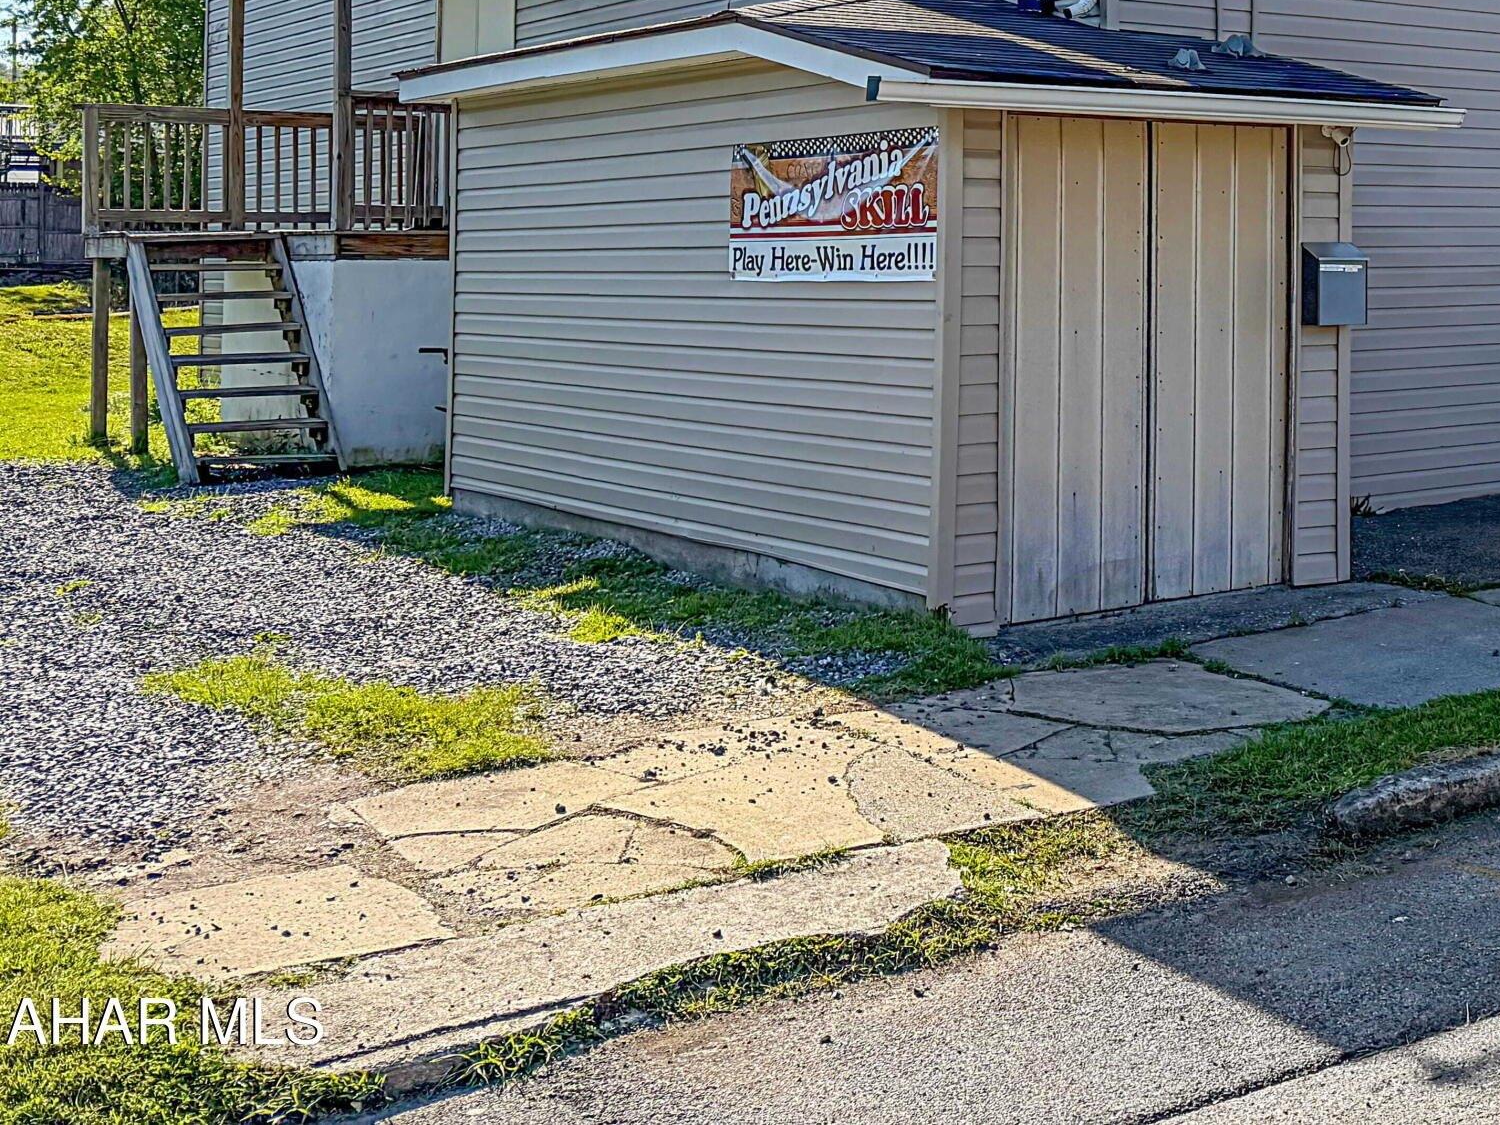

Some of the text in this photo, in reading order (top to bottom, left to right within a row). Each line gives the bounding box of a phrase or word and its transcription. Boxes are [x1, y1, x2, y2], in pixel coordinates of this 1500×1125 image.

[741, 139, 904, 229] Pennsylvania
[841, 183, 929, 230] SKILL
[732, 242, 934, 277] Play Here-Win Here!!!!
